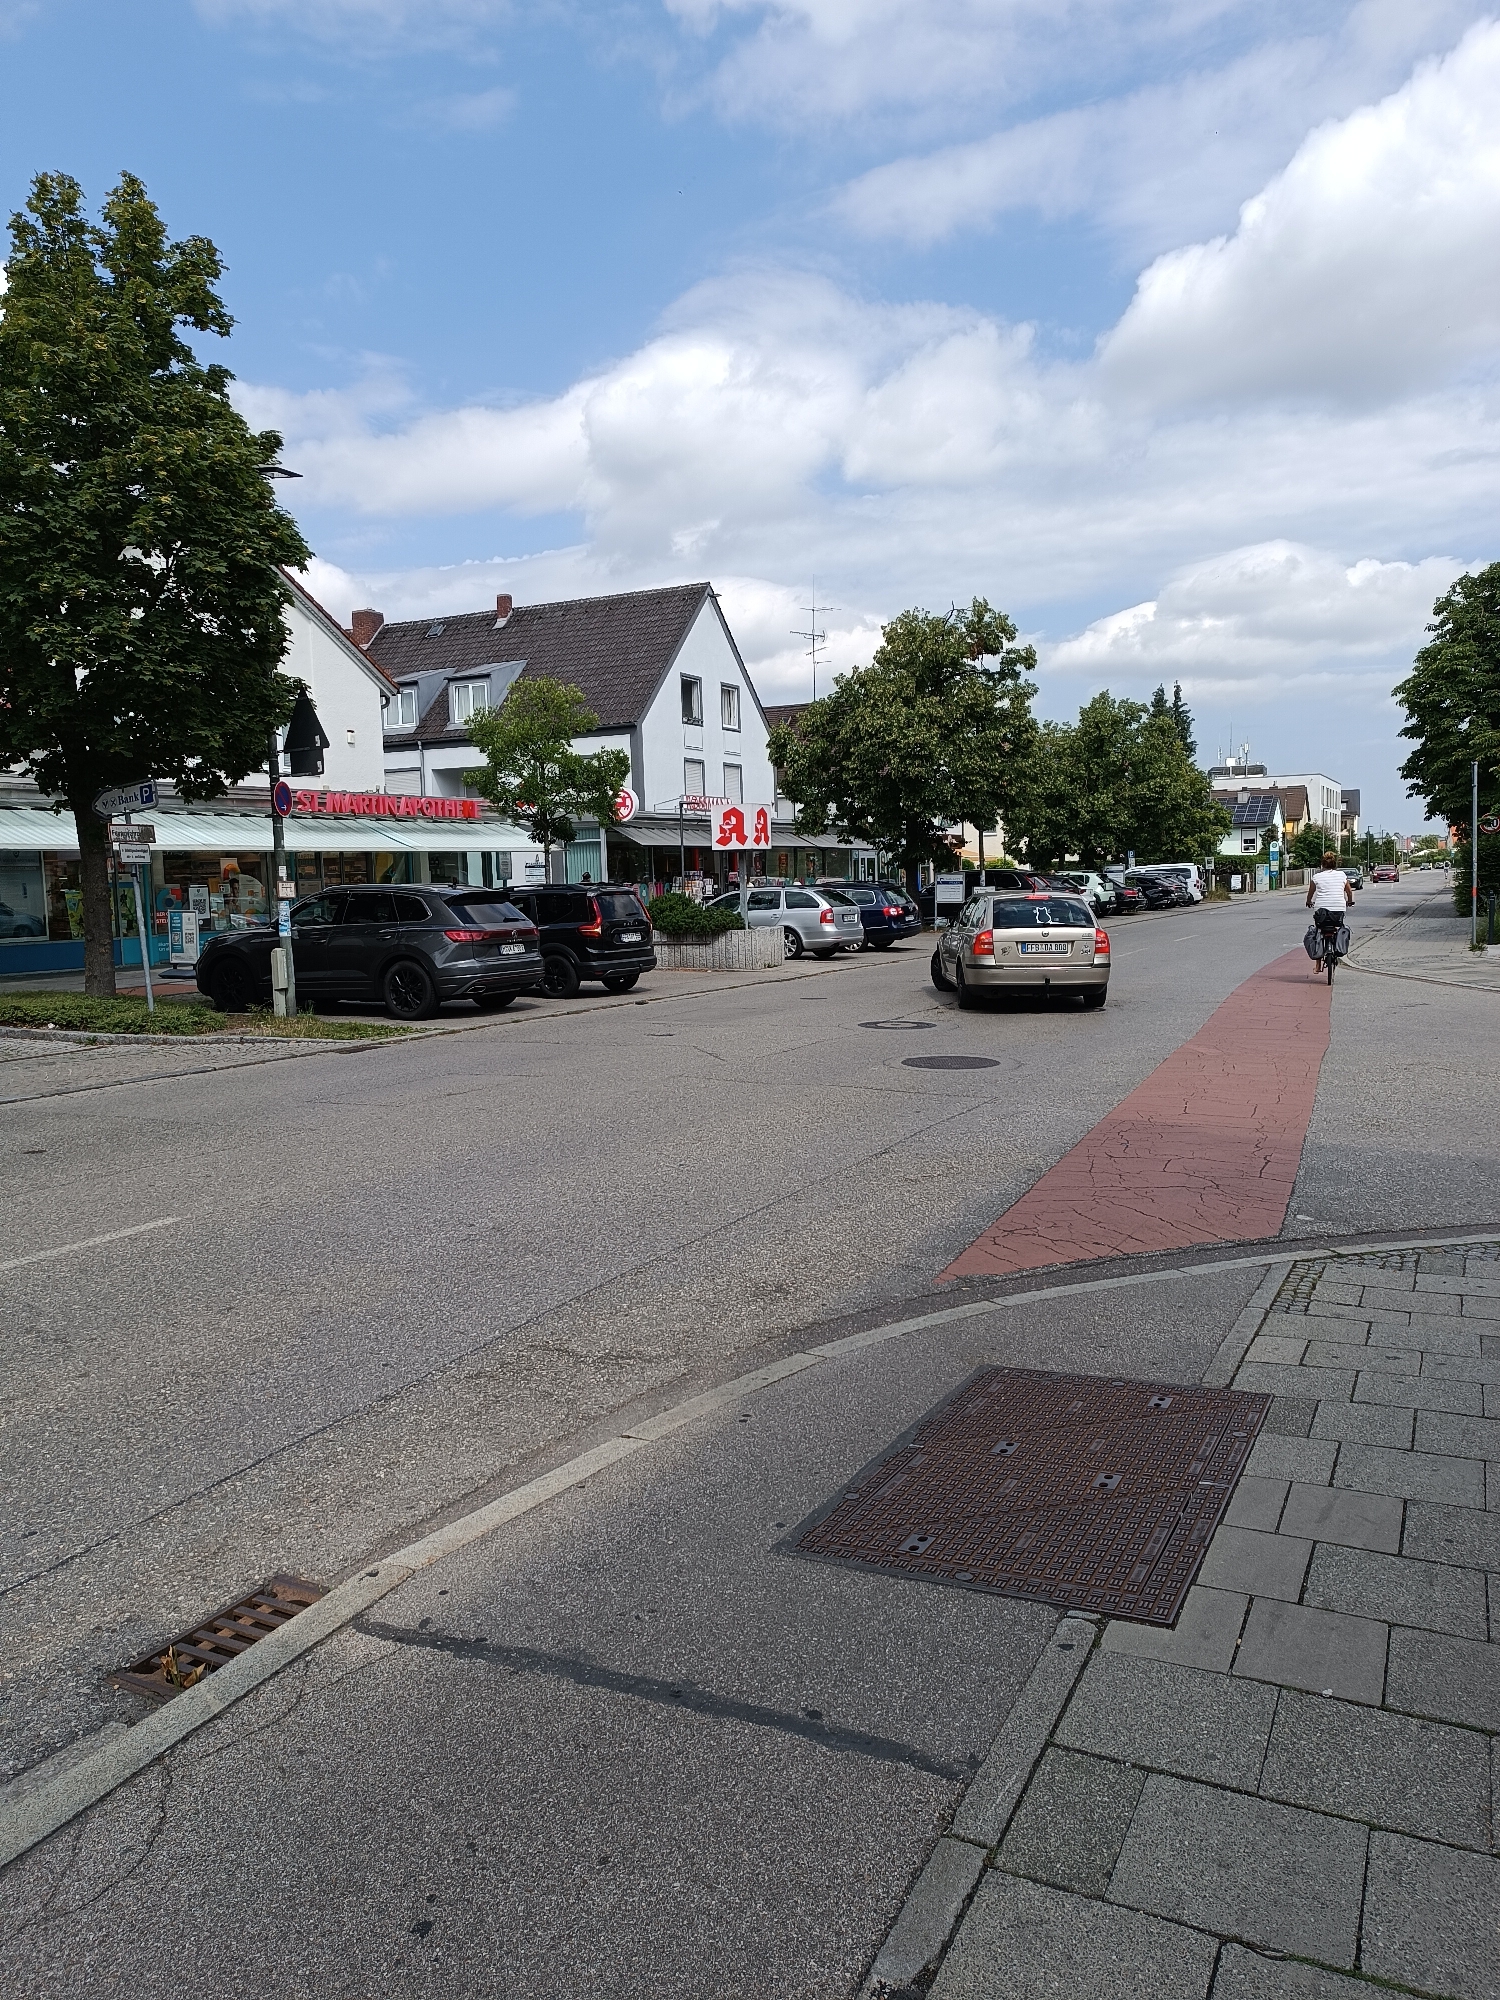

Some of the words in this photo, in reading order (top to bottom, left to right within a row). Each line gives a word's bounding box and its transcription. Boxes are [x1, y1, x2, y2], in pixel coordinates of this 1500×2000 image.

[117, 792, 140, 806] Bank
[142, 787, 150, 802] P
[296, 790, 326, 812] ST.
[326, 792, 398, 816] MARTIN
[399, 797, 482, 819] APOTHEKE
[715, 806, 749, 847] A
[753, 807, 770, 847] A
